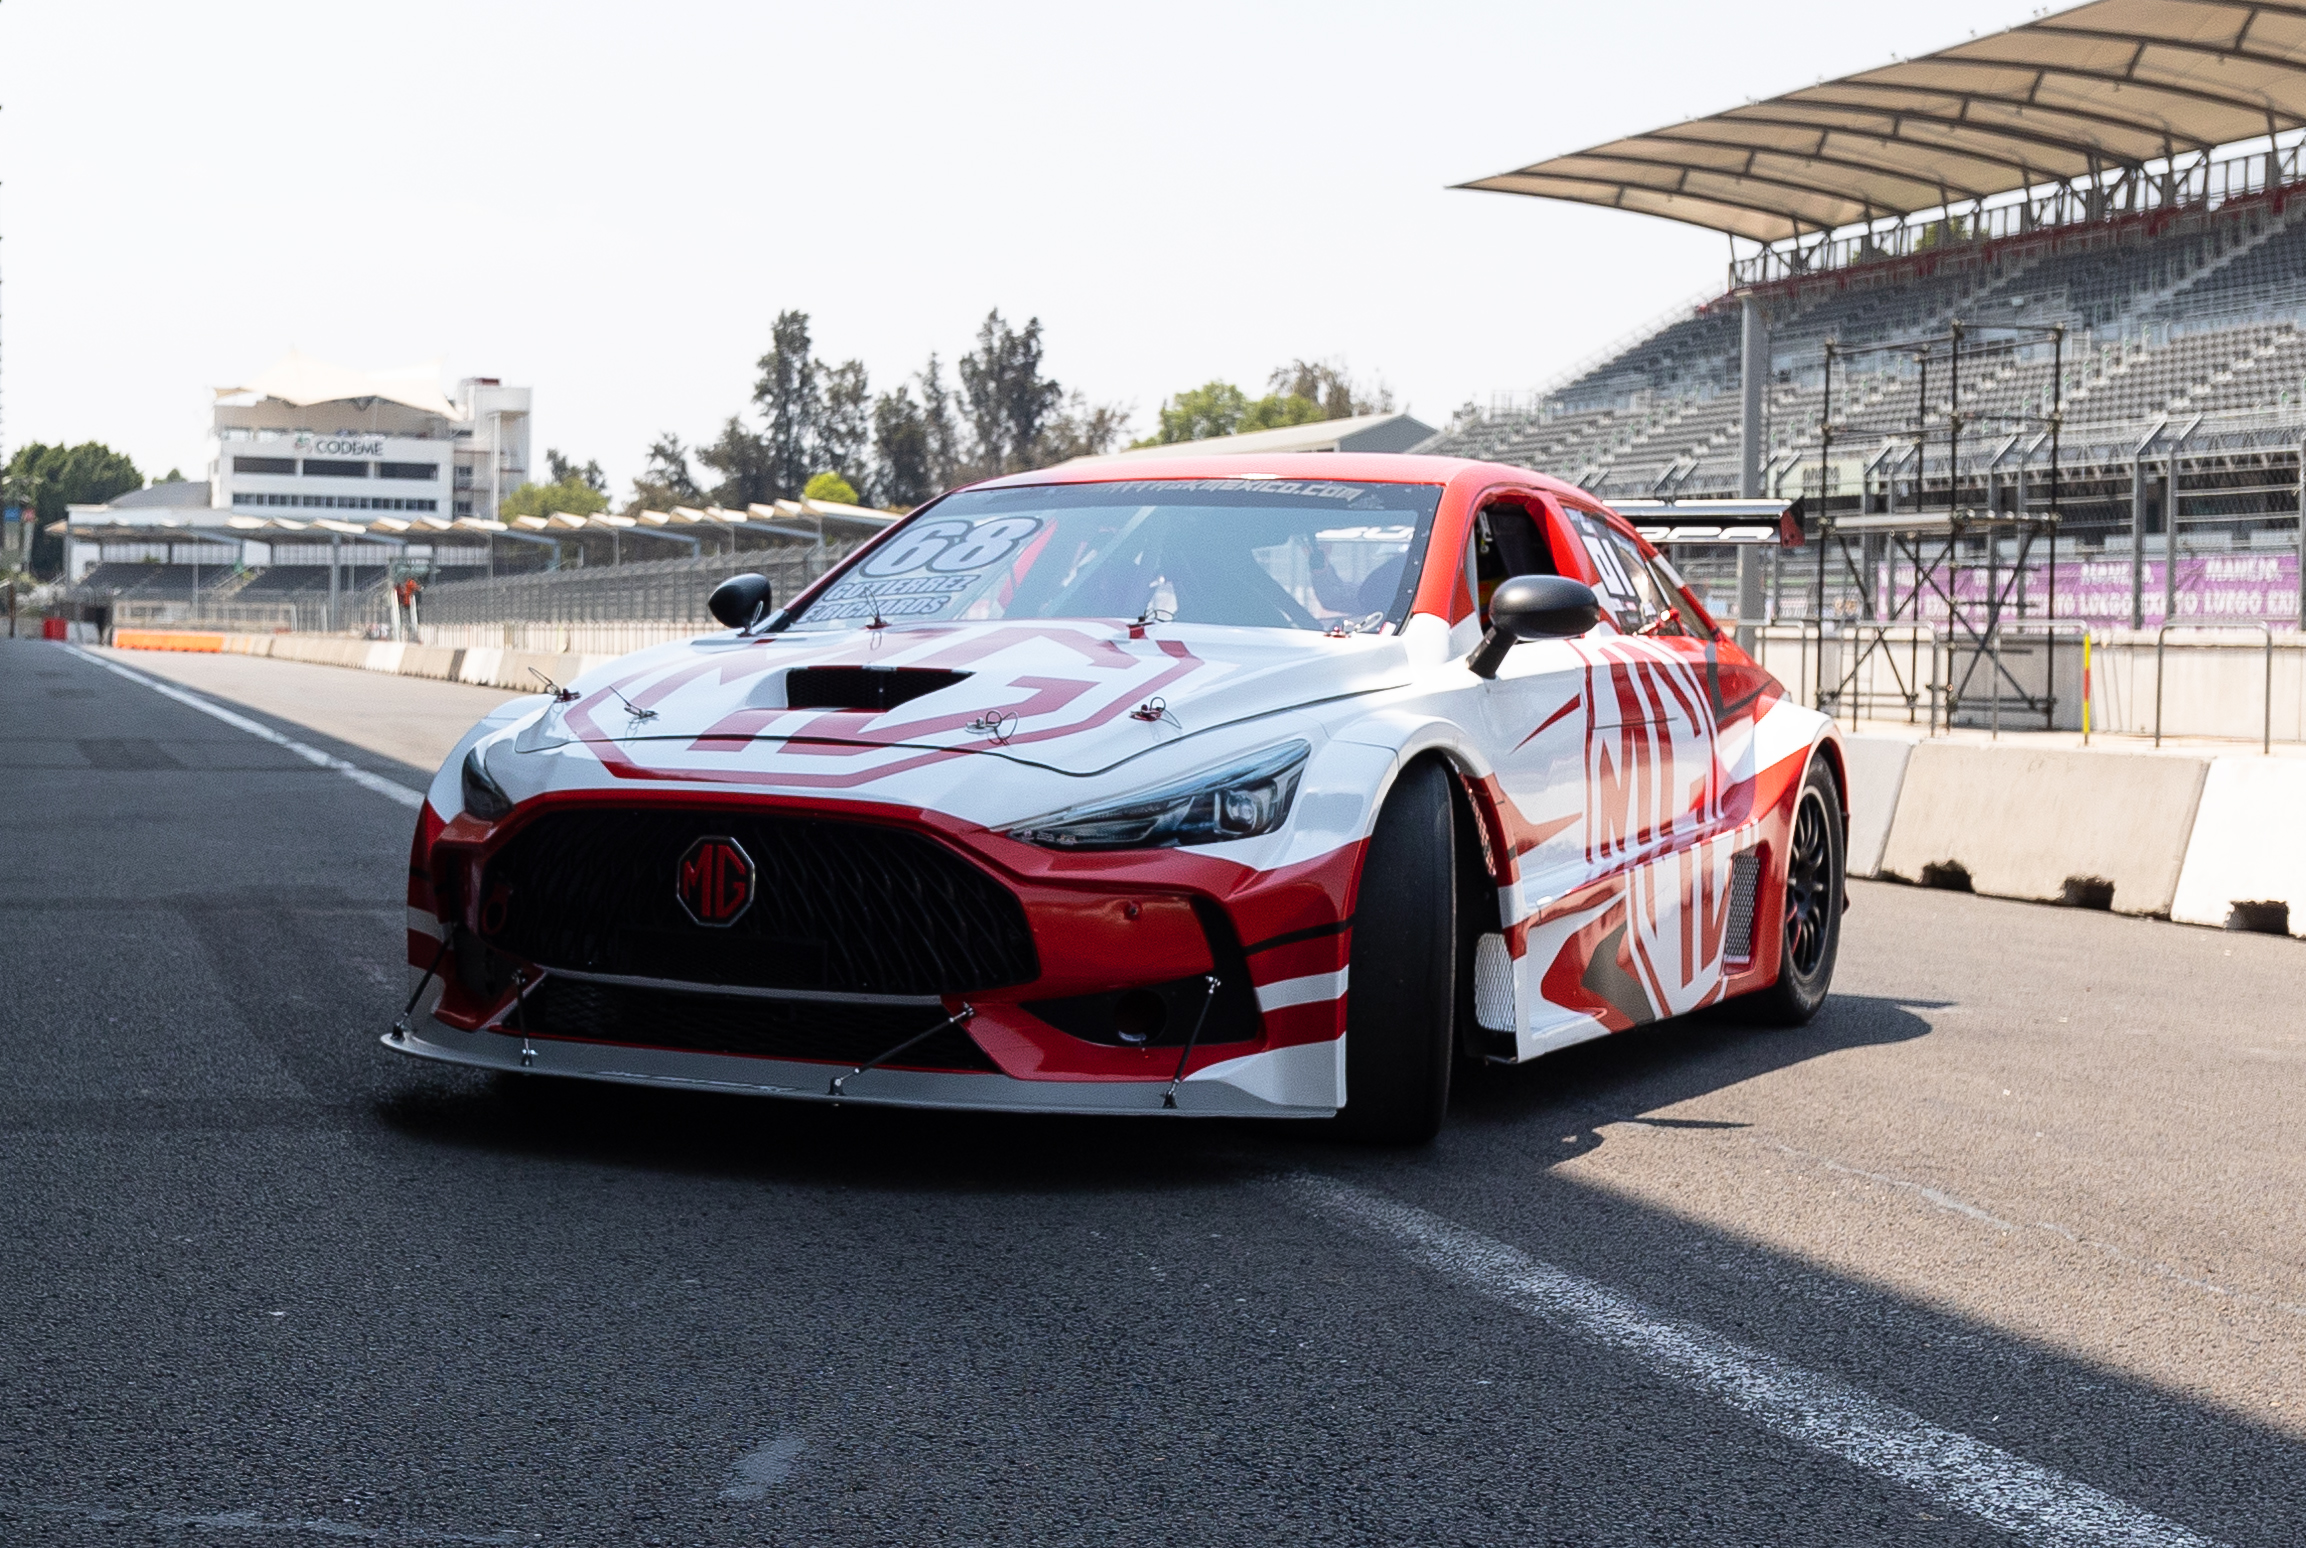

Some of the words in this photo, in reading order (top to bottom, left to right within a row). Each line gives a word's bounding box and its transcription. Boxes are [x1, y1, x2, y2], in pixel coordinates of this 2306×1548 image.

[316, 440, 384, 456] CODEME
[859, 516, 1044, 579] 68
[822, 574, 981, 602] GUTIERREZ
[683, 843, 746, 918] MG
